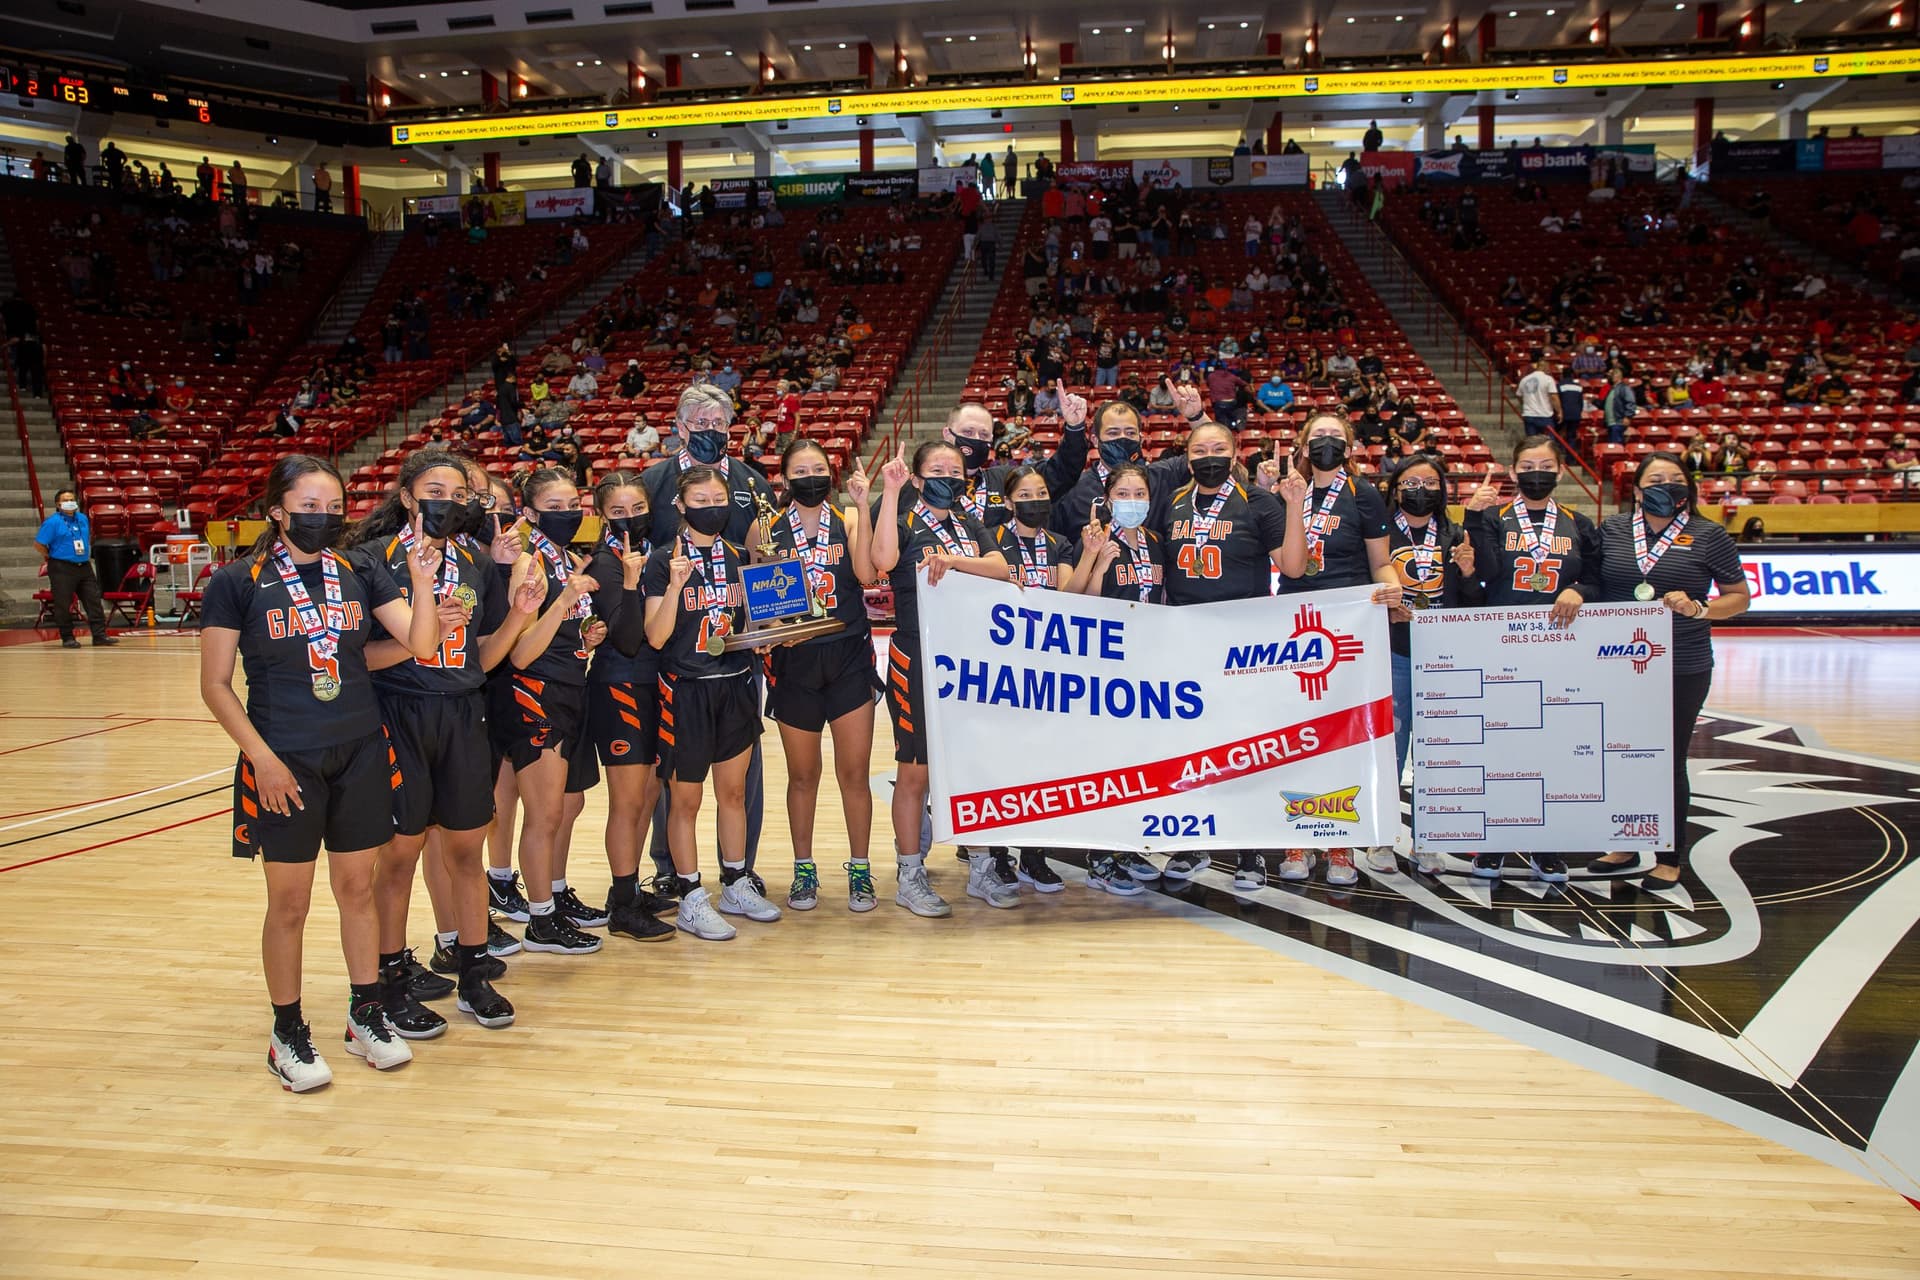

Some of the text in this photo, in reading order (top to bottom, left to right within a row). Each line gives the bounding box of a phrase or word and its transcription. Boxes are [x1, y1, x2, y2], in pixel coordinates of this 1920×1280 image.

[64, 85, 88, 104] 63
[200, 107, 210, 122] 6
[1424, 158, 1456, 169] SONIC
[1100, 166, 1130, 178] CLASS
[1143, 168, 1170, 176] NMAA
[777, 179, 838, 195] SUBWAY
[1177, 544, 1222, 579] 40
[1512, 556, 1562, 593] 25
[752, 577, 785, 591] NMAA
[810, 572, 838, 608] 2
[1417, 615, 1438, 624] 2021
[1441, 614, 1471, 623] NMAA
[1473, 612, 1504, 622] STATE
[1577, 607, 1664, 618] CHAMPIONSHIPS
[989, 603, 1125, 661] STATE
[1509, 622, 1527, 632] MAY
[1530, 622, 1546, 631] 3-8,
[1501, 632, 1576, 644] GIRLS CLASS 4A
[1224, 637, 1323, 670] NMAA
[1597, 644, 1646, 656] NMAA
[1237, 667, 1257, 675] MEXICO
[1259, 664, 1288, 673] ACTIVITIES
[1289, 661, 1324, 671] ASSOCIATION
[934, 653, 1204, 720] CHAMPIONS
[1426, 709, 1457, 717] Highland
[1606, 742, 1631, 751] Gallup
[957, 726, 1320, 828] BASKETBALL 4A GIRLS
[1516, 770, 1541, 778] Central
[1545, 793, 1579, 801] Española
[1288, 795, 1355, 817] SONIC
[1142, 814, 1216, 837] 2021
[1295, 821, 1335, 830] America's
[1486, 817, 1519, 825] Española
[1611, 814, 1659, 823] COMPETE
[1428, 831, 1460, 839] Española
[1462, 831, 1482, 839] Valley
[1624, 823, 1659, 837] CLASS
